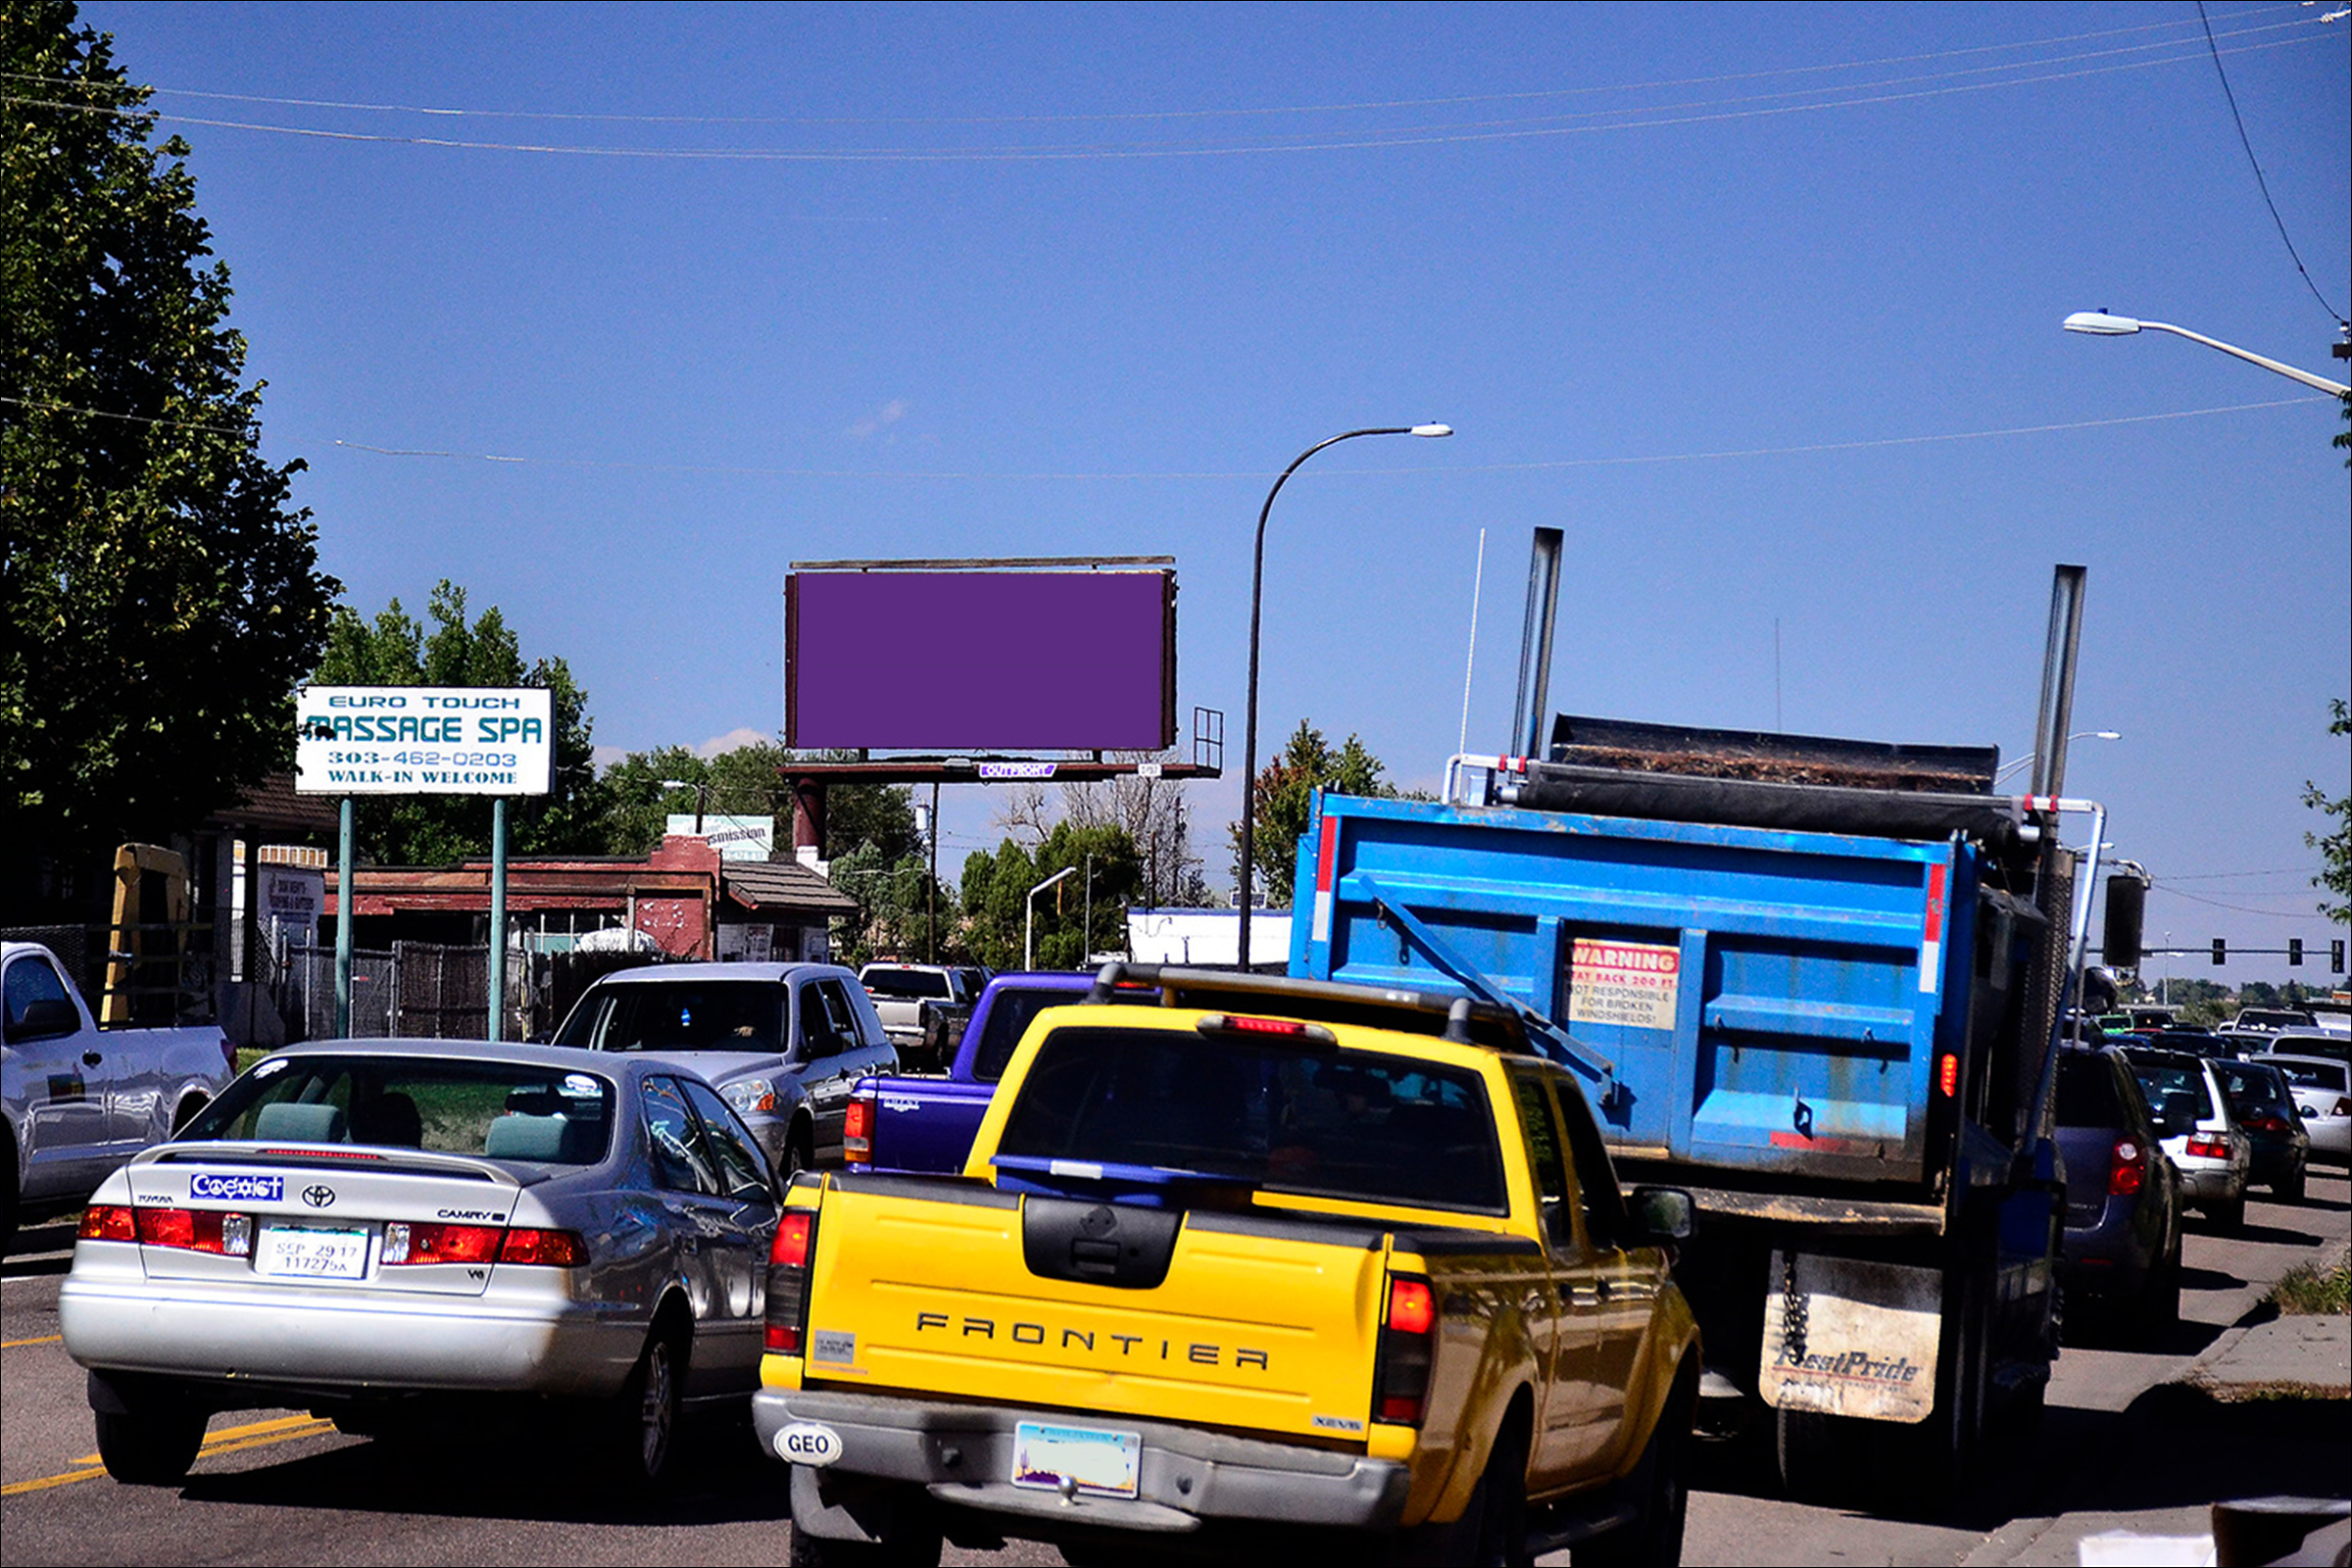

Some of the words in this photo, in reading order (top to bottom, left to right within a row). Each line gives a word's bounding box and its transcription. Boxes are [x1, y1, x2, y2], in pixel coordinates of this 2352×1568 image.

[328, 696, 407, 709] EURO
[421, 697, 520, 710] TOUCH
[478, 716, 542, 743] SPA
[328, 751, 517, 767] 303-462-0203
[328, 770, 414, 783] WALK-IN
[421, 771, 517, 784] WELCOME
[1573, 947, 1676, 972] WARNING
[1633, 976, 1656, 986] 200
[1572, 984, 1590, 995] OT
[1592, 985, 1669, 1003] RESPONSIBLE
[1581, 998, 1603, 1007] FOR
[1606, 999, 1653, 1011] BROKEN
[437, 1208, 490, 1220] CAMRY
[276, 1242, 306, 1254] SEP
[316, 1245, 335, 1257] 29
[467, 1269, 484, 1280] V6
[916, 1312, 1268, 1370] FRONTIER
[788, 1434, 829, 1454] GEO
